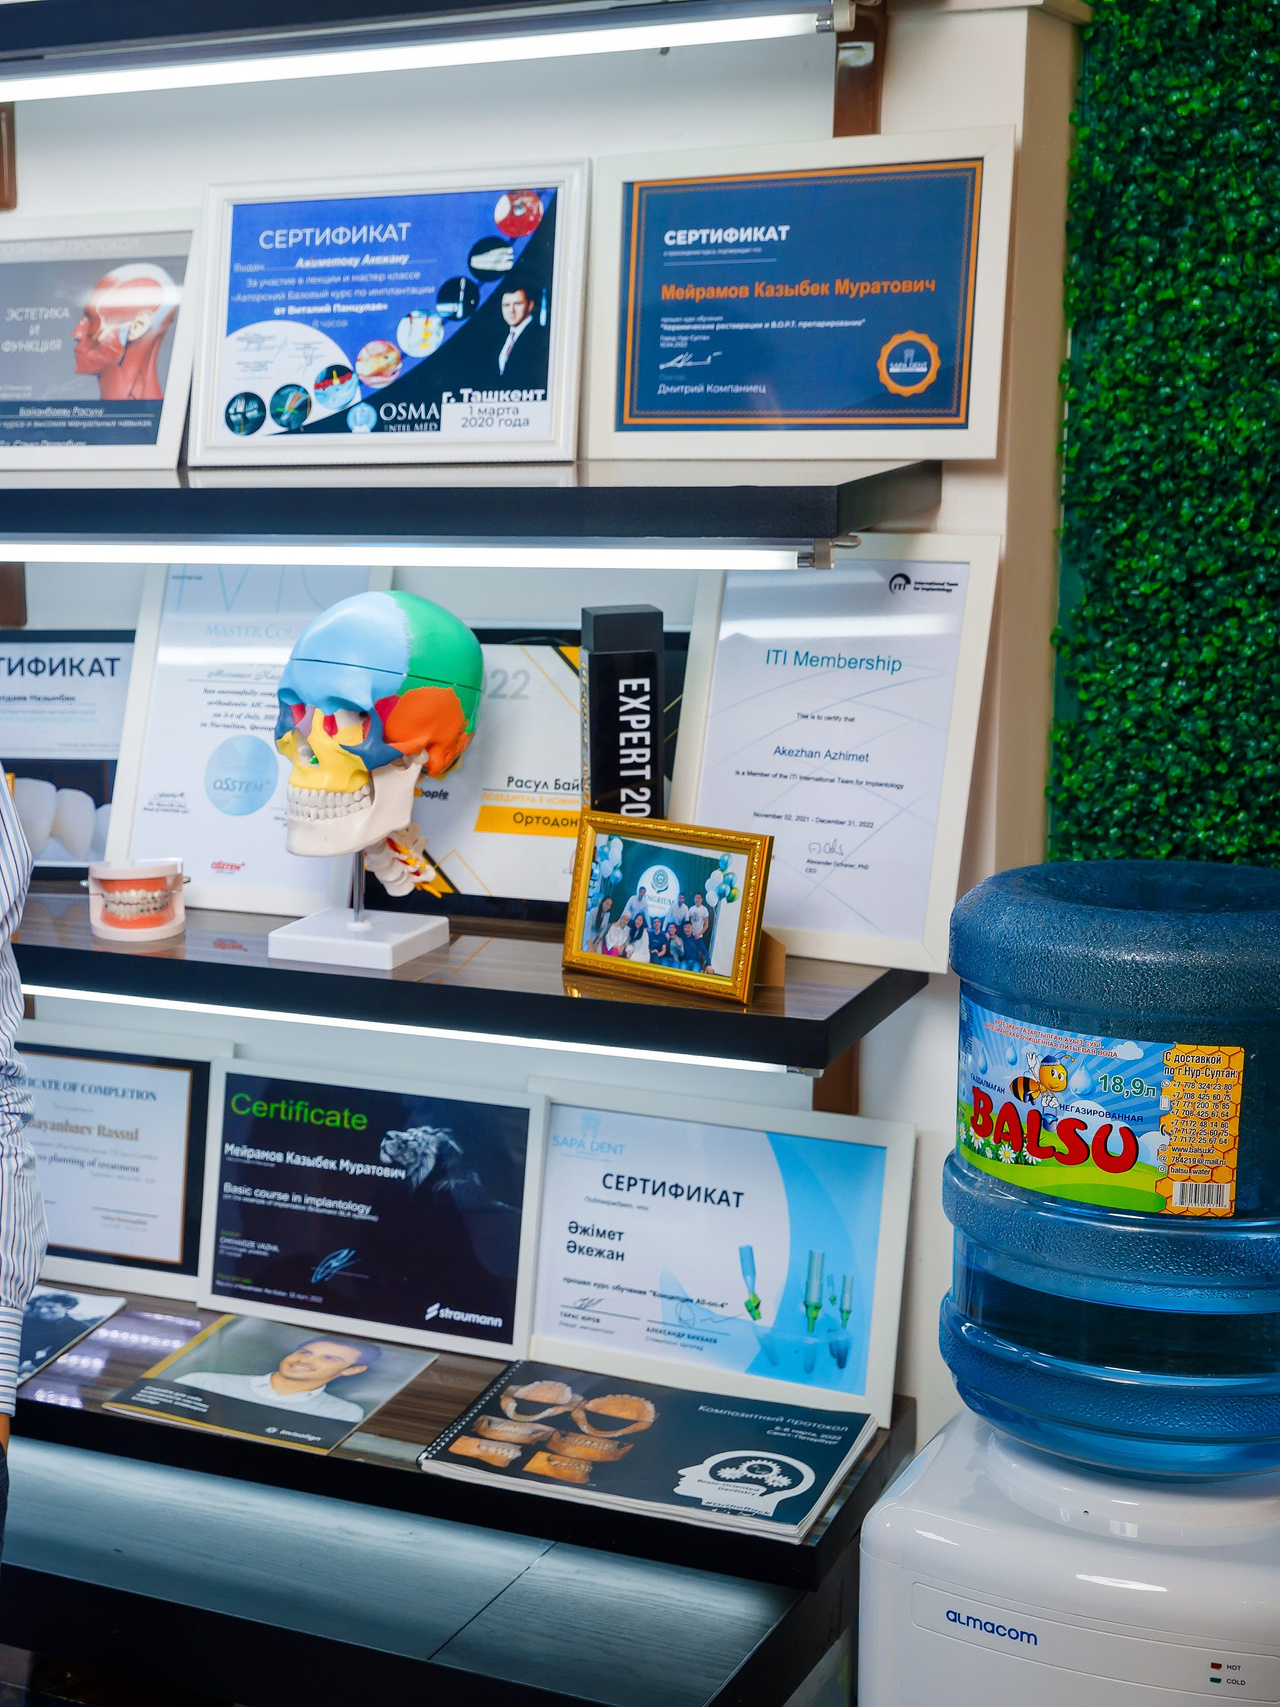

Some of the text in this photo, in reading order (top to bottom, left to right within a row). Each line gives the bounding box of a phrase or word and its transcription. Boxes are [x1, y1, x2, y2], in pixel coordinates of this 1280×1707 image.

[259, 222, 412, 250] СЕРТИФИКАТ
[664, 225, 791, 245] СЕРТИФИКАТ
[259, 276, 296, 289] участие
[305, 275, 341, 286] лекции
[352, 272, 386, 284] мастер
[387, 271, 421, 281] классе
[330, 289, 353, 300] курс
[354, 288, 367, 297] по
[368, 285, 436, 297] имплантации
[661, 277, 937, 303] Мейрамов Казыбек Муратович
[4, 305, 71, 322] ЭСТЕТИКА
[28, 323, 41, 337] И
[1, 337, 63, 353] ФУНКЦИЯ
[441, 388, 546, 404] г. Ташкент
[657, 383, 767, 395] Дмитрий Компаниец
[379, 402, 440, 421] OSMA
[477, 405, 519, 418] марта
[461, 417, 530, 428] 2020 года
[766, 649, 903, 675] ITI Membership
[483, 668, 531, 700] 22
[797, 712, 809, 720] This
[824, 715, 842, 723] certify
[618, 677, 651, 818] EXPERT 20
[773, 745, 870, 763] Akezhan Azhimet
[506, 776, 549, 793] Расул
[746, 770, 770, 778] Member
[799, 774, 835, 783] International
[837, 777, 854, 785] Team
[865, 779, 905, 790] Implantology
[482, 792, 537, 804] ПОБЕДИТЕЛЬ
[513, 812, 579, 827] Ортодон
[753, 811, 783, 820] November
[815, 817, 846, 826] December
[859, 821, 874, 829] 2022
[984, 1022, 1119, 1059] АРТЕЗИАНСКАЯ ОЧИЩЕННАЯ ПИТЬЕВАЯ ВОДА
[994, 1019, 1102, 1048] АРТЕЗИАН АУЫЗ СУЫ
[1165, 1051, 1222, 1065] С доставкой
[1164, 1066, 1239, 1079] по г.Нур-Султан:
[63, 1080, 158, 1101] OF COMPLETION
[1098, 1073, 1157, 1099] 18,9л
[1183, 1092, 1196, 1100] 708
[230, 1092, 369, 1131] Certificate
[1059, 1103, 1144, 1123] НЕГАЗИРОВАННАЯ
[1181, 1109, 1194, 1117] 708
[970, 1085, 1140, 1175] BALSU
[1180, 1120, 1197, 1128] 7172
[1180, 1128, 1197, 1136] 7172
[552, 1134, 626, 1156] SAPA DENT
[1179, 1136, 1196, 1144] 7172
[1171, 1146, 1215, 1154] www.balsu.kz
[48, 1151, 86, 1168] planning
[224, 1142, 285, 1164] Мейрамов
[285, 1151, 338, 1171] Казыбек
[339, 1158, 408, 1181] Муратович
[1171, 1156, 1227, 1166] 784219@mail.ru
[1170, 1167, 1211, 1176] balsu_water
[223, 1181, 372, 1216] Basic course in implantology
[602, 1172, 745, 1209] СЕРТИФИКАТ
[568, 1220, 625, 1242] Әжімет
[566, 1239, 625, 1263] Әкежан
[593, 1281, 610, 1291] курс
[611, 1284, 647, 1297] обучения
[438, 1306, 503, 1328] straumann
[697, 1404, 850, 1433] Композитный протокол
[279, 1427, 322, 1442] invisalign
[717, 1486, 757, 1497] Dentistry
[1226, 1664, 1242, 1672] HOT
[1226, 1678, 1246, 1686] COLD
